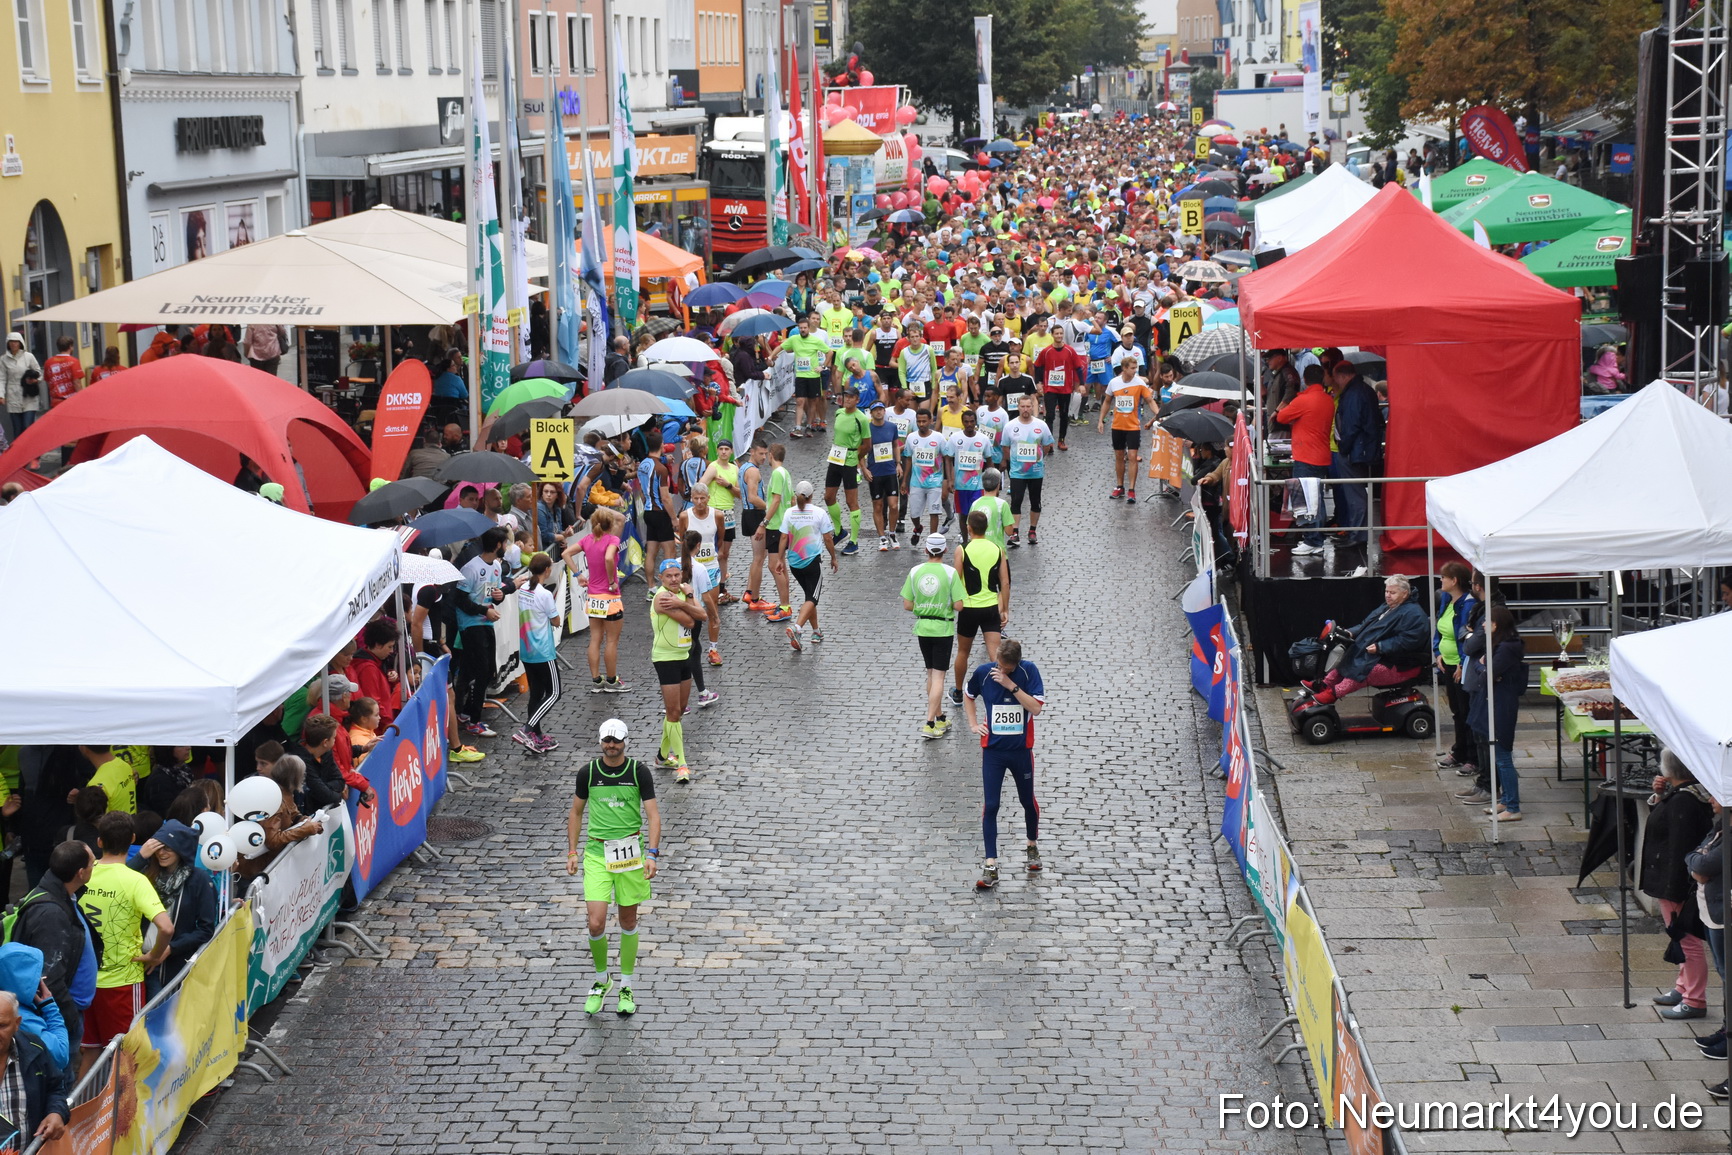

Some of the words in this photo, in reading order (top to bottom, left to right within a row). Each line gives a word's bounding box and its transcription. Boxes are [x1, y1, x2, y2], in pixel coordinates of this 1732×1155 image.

[1195, 112, 1201, 121] D
[185, 117, 227, 151] BRILLEN
[229, 115, 266, 148] WEBER
[1469, 117, 1503, 158] Hervis
[884, 140, 903, 160] AVIA
[1199, 143, 1207, 154] C
[723, 203, 748, 215] AVIA
[1515, 207, 1570, 217] Neumarkter
[1187, 210, 1198, 227] B
[1506, 211, 1582, 223] Lammsbräu
[191, 294, 311, 304] Neumarkter
[158, 302, 325, 316] Lammsbräu
[1173, 309, 1198, 318] Block
[1177, 321, 1193, 344] A
[386, 393, 414, 406] DKMS
[536, 421, 569, 433] Block
[540, 438, 565, 468] A
[833, 449, 841, 458] 12
[880, 446, 889, 455] 99
[916, 451, 934, 460] 2678
[1019, 448, 1035, 456] 2011
[925, 577, 935, 585] SC
[592, 599, 605, 609] 616
[994, 711, 1022, 724] 2580
[391, 754, 422, 811] Hervis
[355, 804, 378, 866] Hervis
[612, 845, 635, 860] 111
[609, 860, 639, 870] FrankenBlitz
[97, 888, 117, 898] Partl
